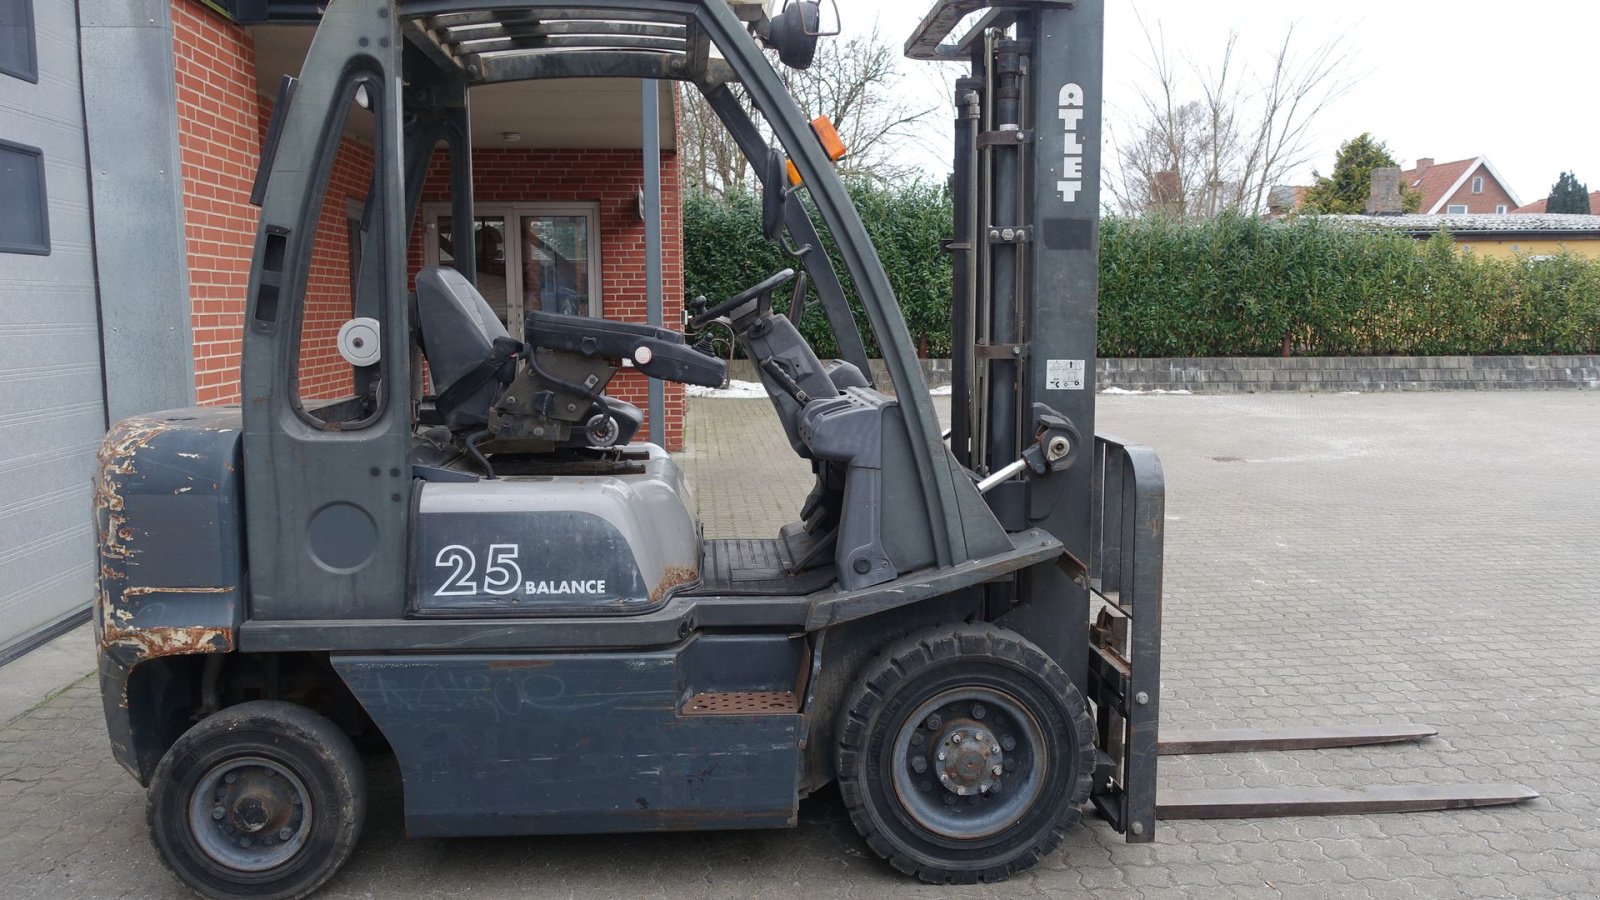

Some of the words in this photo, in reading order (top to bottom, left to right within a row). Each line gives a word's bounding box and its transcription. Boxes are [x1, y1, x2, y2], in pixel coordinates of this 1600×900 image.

[1057, 82, 1084, 203] ATLET
[433, 543, 523, 597] 25
[525, 579, 606, 595] BALANCE
